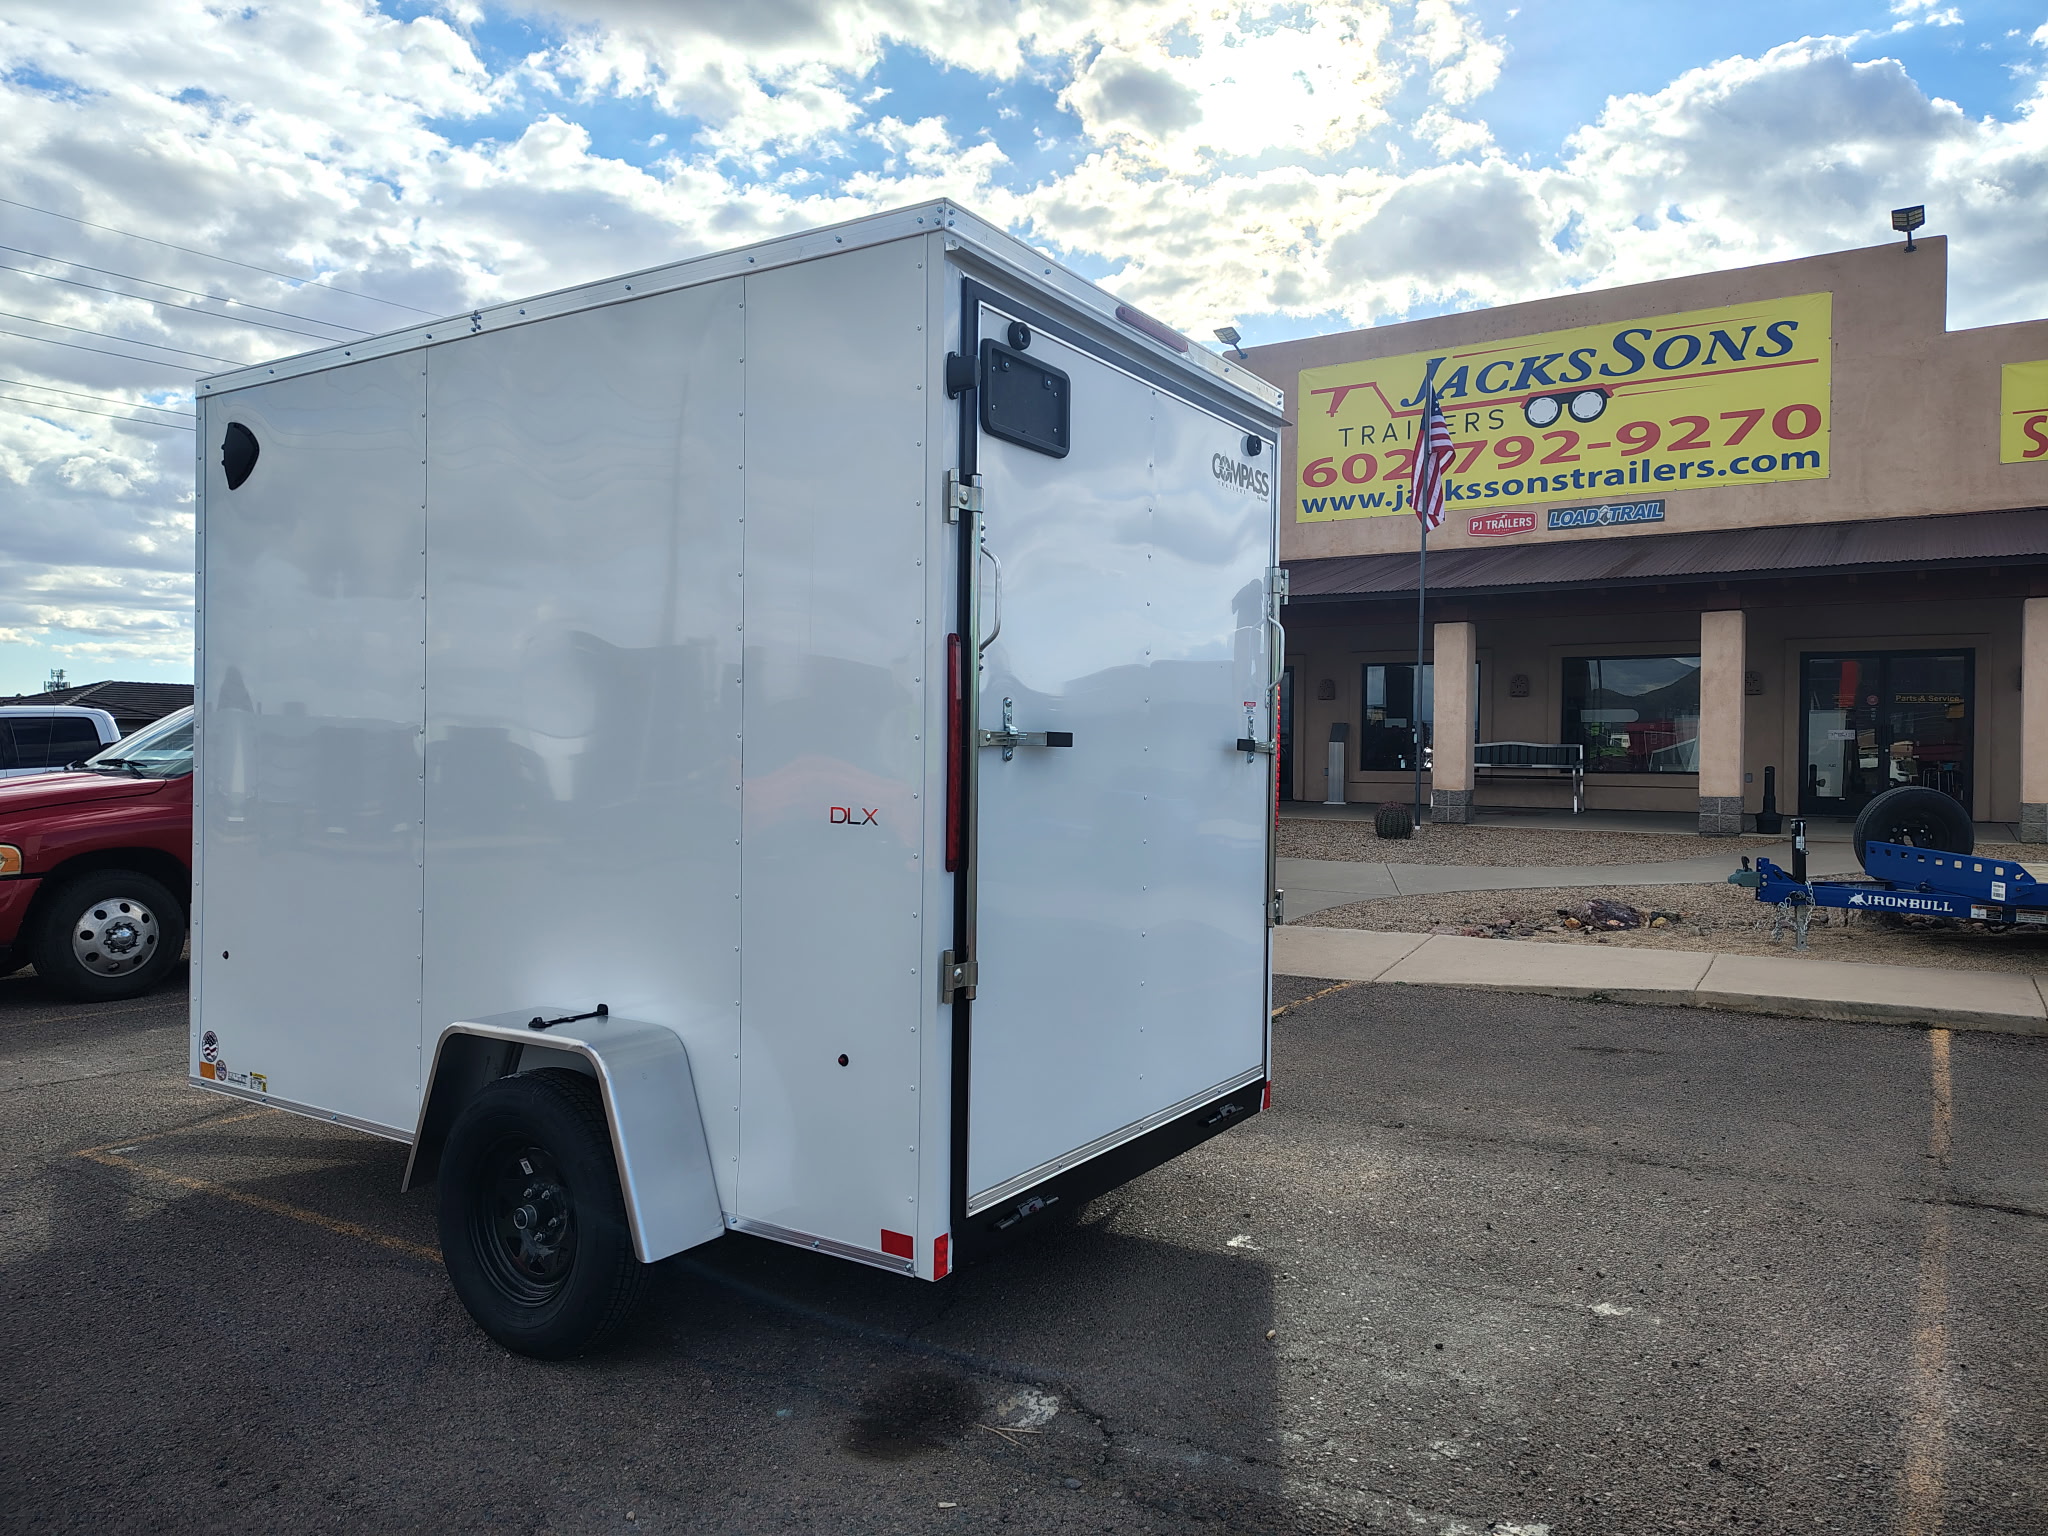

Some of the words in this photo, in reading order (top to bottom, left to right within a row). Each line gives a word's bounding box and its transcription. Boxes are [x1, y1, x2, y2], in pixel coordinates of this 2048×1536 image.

[1338, 408, 1505, 448] TRAIERS
[1302, 403, 1822, 488] 602792-9270
[1211, 452, 1270, 497] COMPASS
[1301, 450, 1820, 514] www.jkssonstrailers.com
[1472, 521, 1483, 531] PJ
[1485, 516, 1533, 530] TRAILERS
[1548, 508, 1599, 528] LOAD
[1608, 502, 1664, 522] TRAIL
[1895, 694, 1918, 702] Parts
[1928, 694, 1960, 703] Service
[830, 806, 879, 826] DLX
[1867, 894, 1953, 913] IRONBULL
